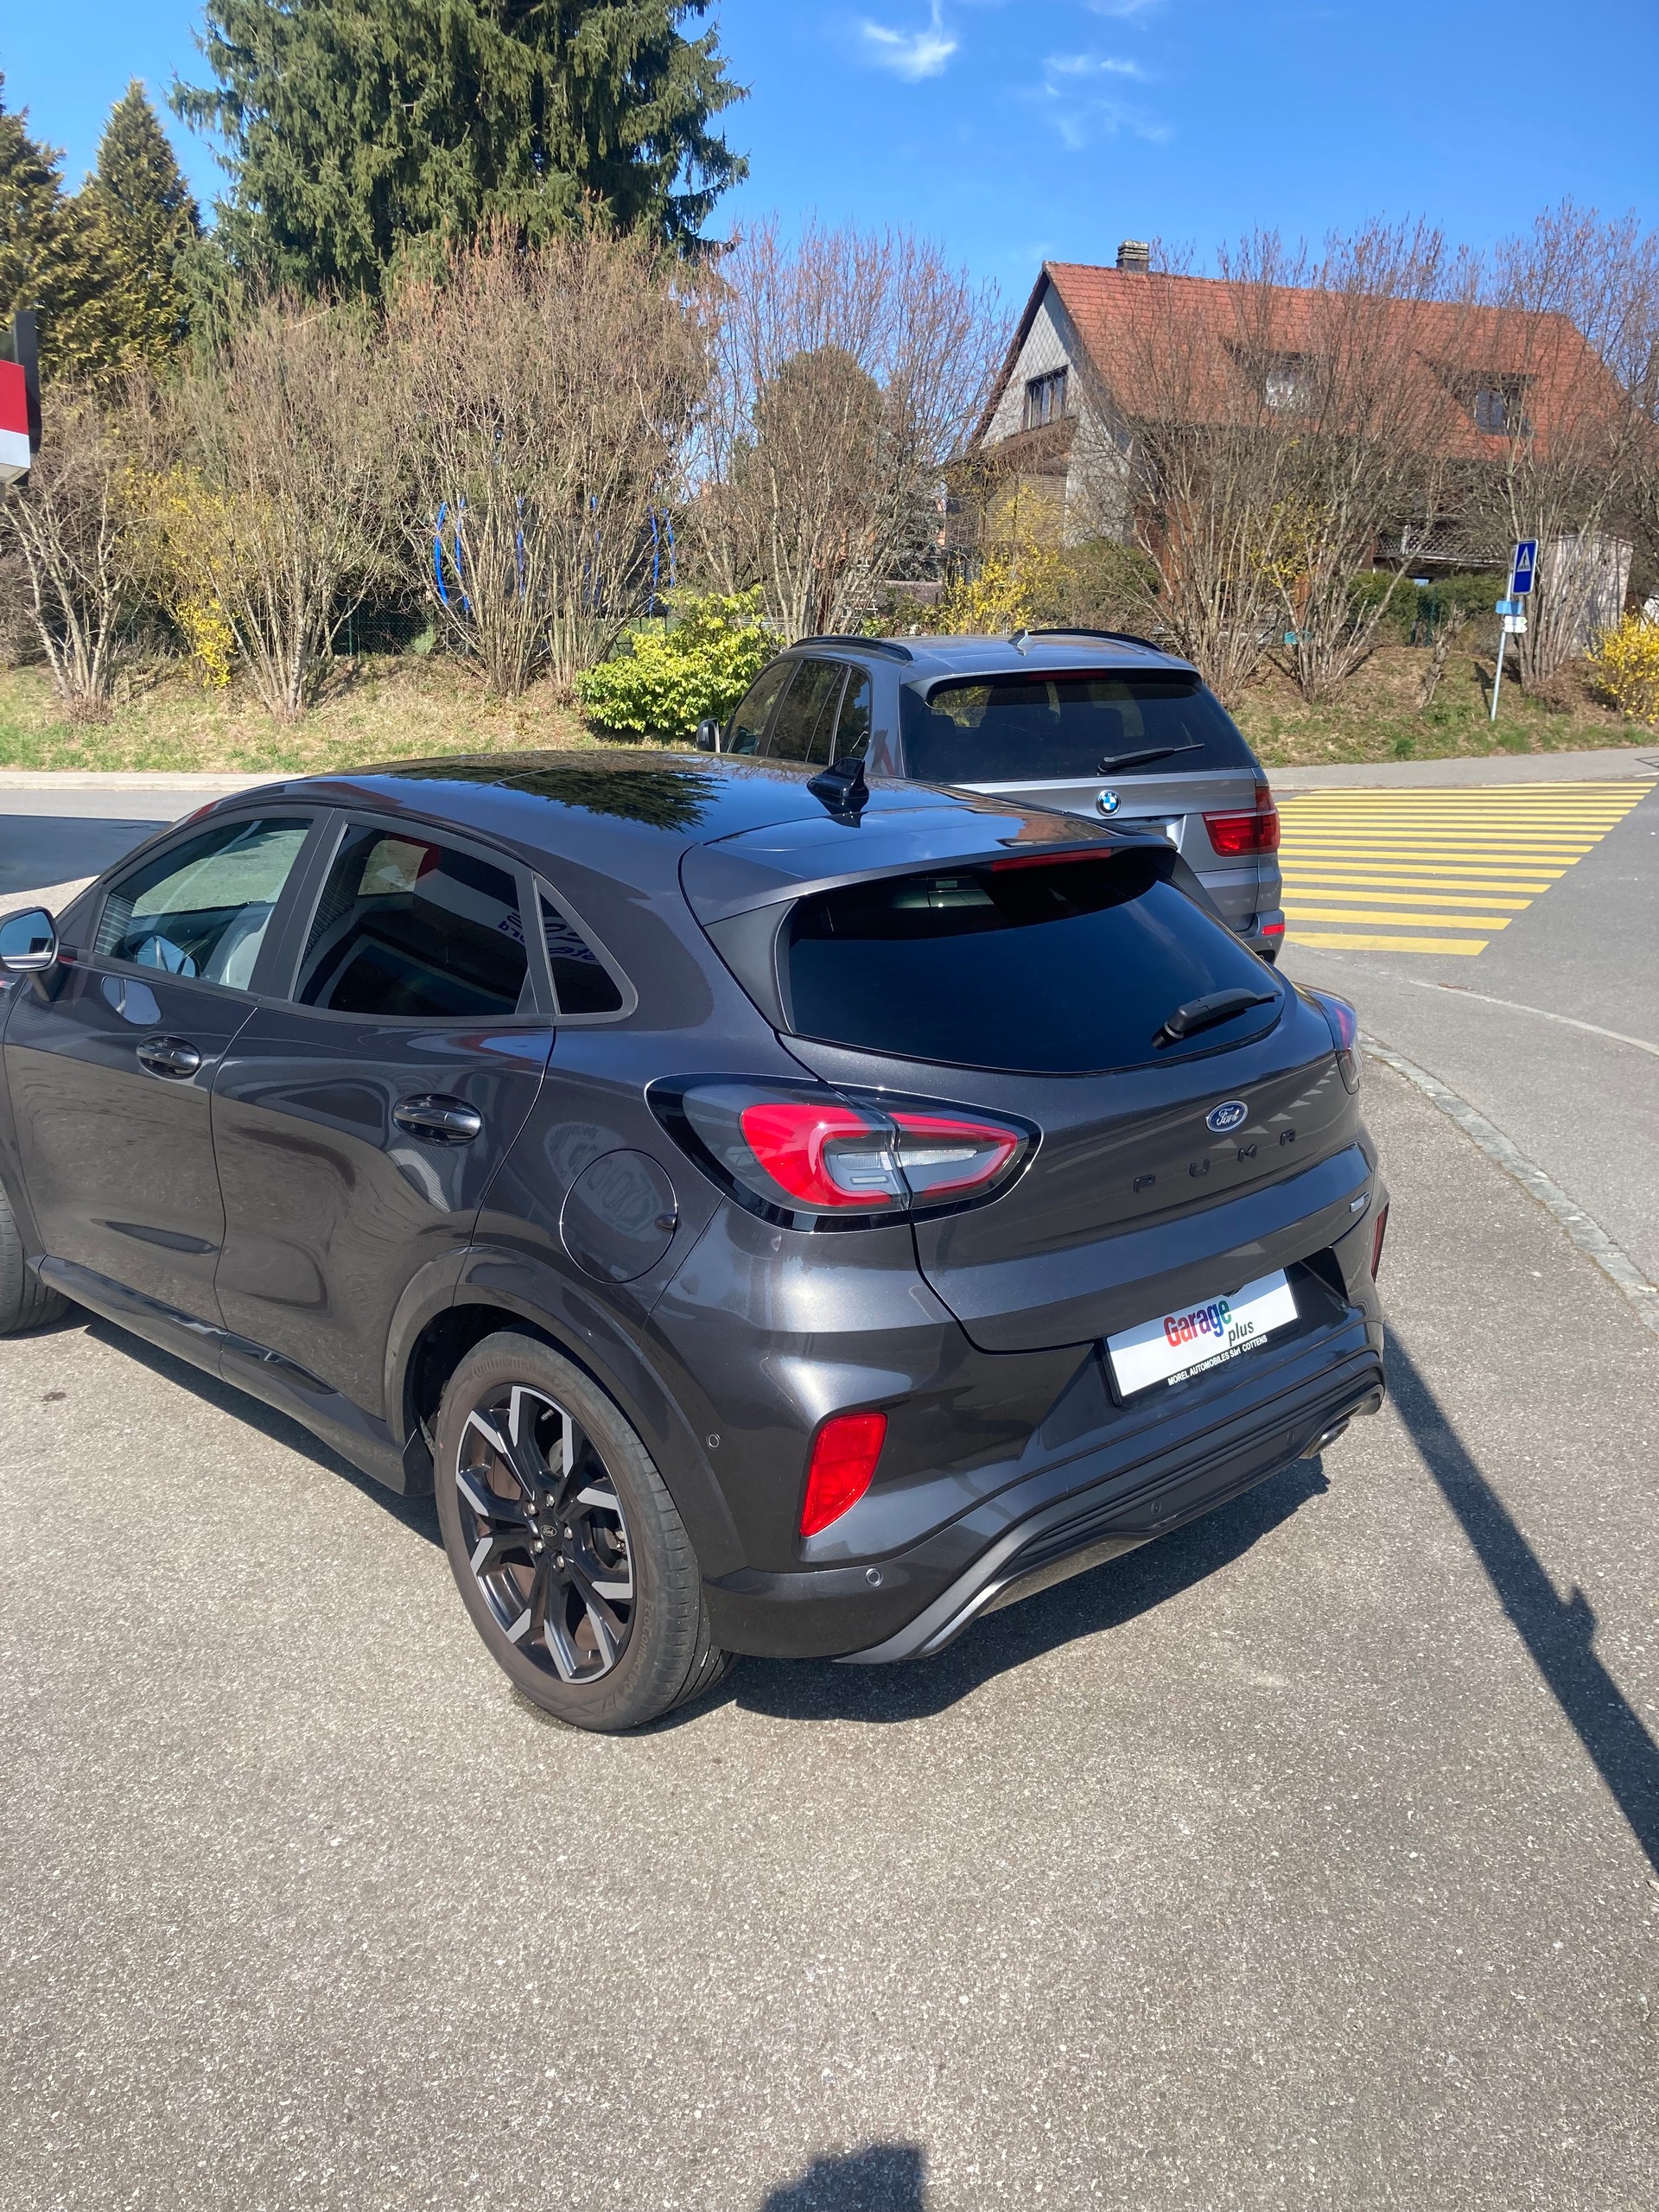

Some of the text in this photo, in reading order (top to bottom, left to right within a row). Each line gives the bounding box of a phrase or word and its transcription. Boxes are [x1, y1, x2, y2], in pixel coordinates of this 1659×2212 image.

[1216, 1106, 1241, 1127] Ford
[1133, 1128, 1296, 1193] PUMA
[1163, 1300, 1232, 1348] Garage
[1228, 1320, 1255, 1347] plus
[1167, 1370, 1190, 1386] MOREL
[1190, 1351, 1230, 1376] AUTOMOBILES
[1242, 1334, 1268, 1352] COTTENS
